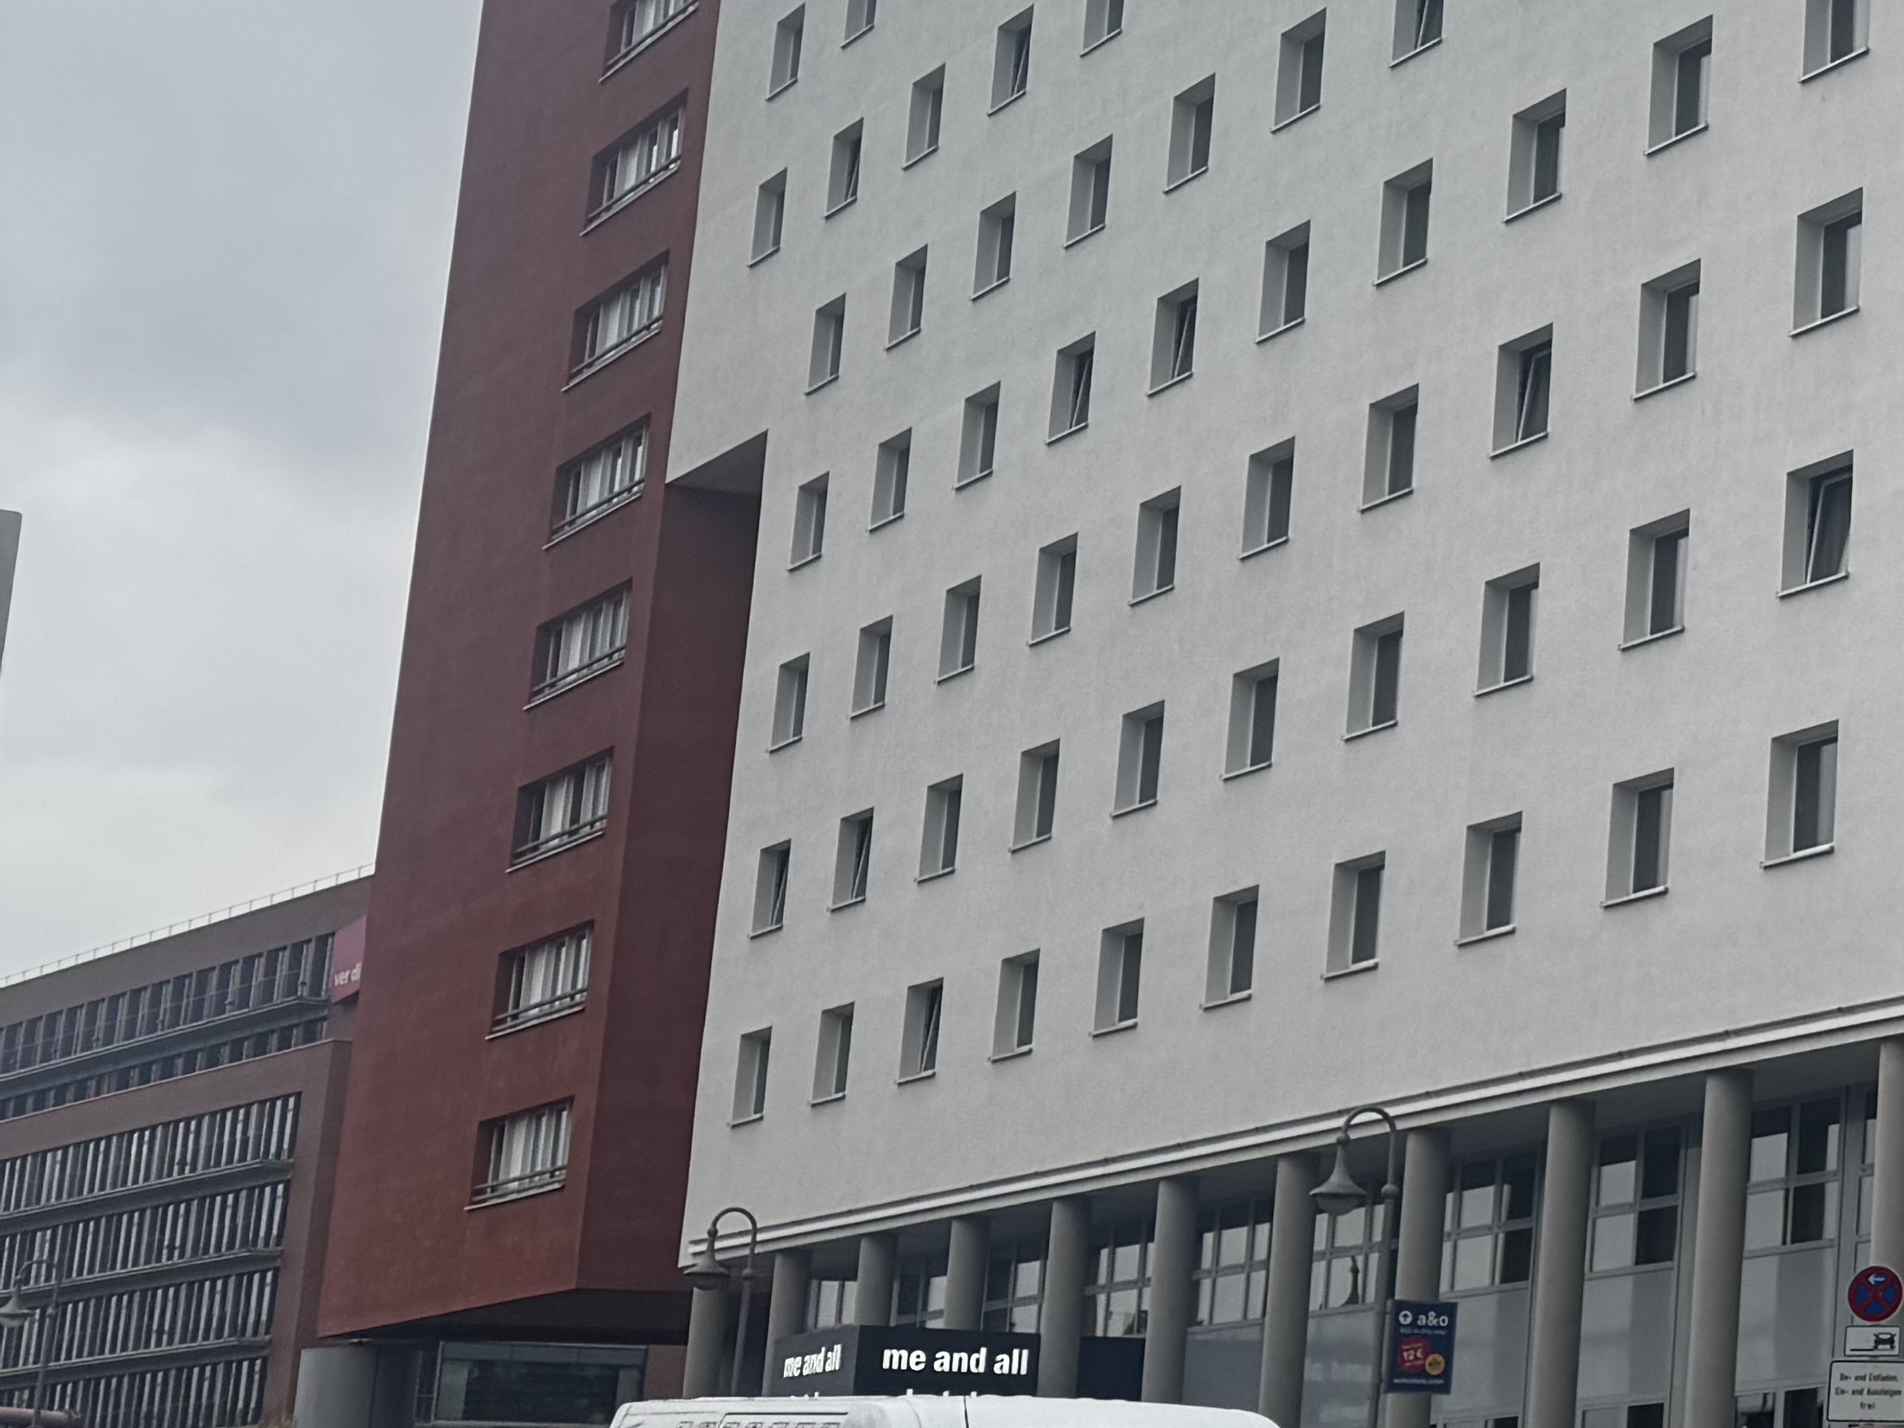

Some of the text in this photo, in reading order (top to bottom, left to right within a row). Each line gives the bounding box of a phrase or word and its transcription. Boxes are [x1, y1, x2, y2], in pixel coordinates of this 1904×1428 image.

[1417, 1311, 1448, 1326] a&o
[783, 1344, 842, 1378] me and all
[882, 1347, 1029, 1375] me and all
